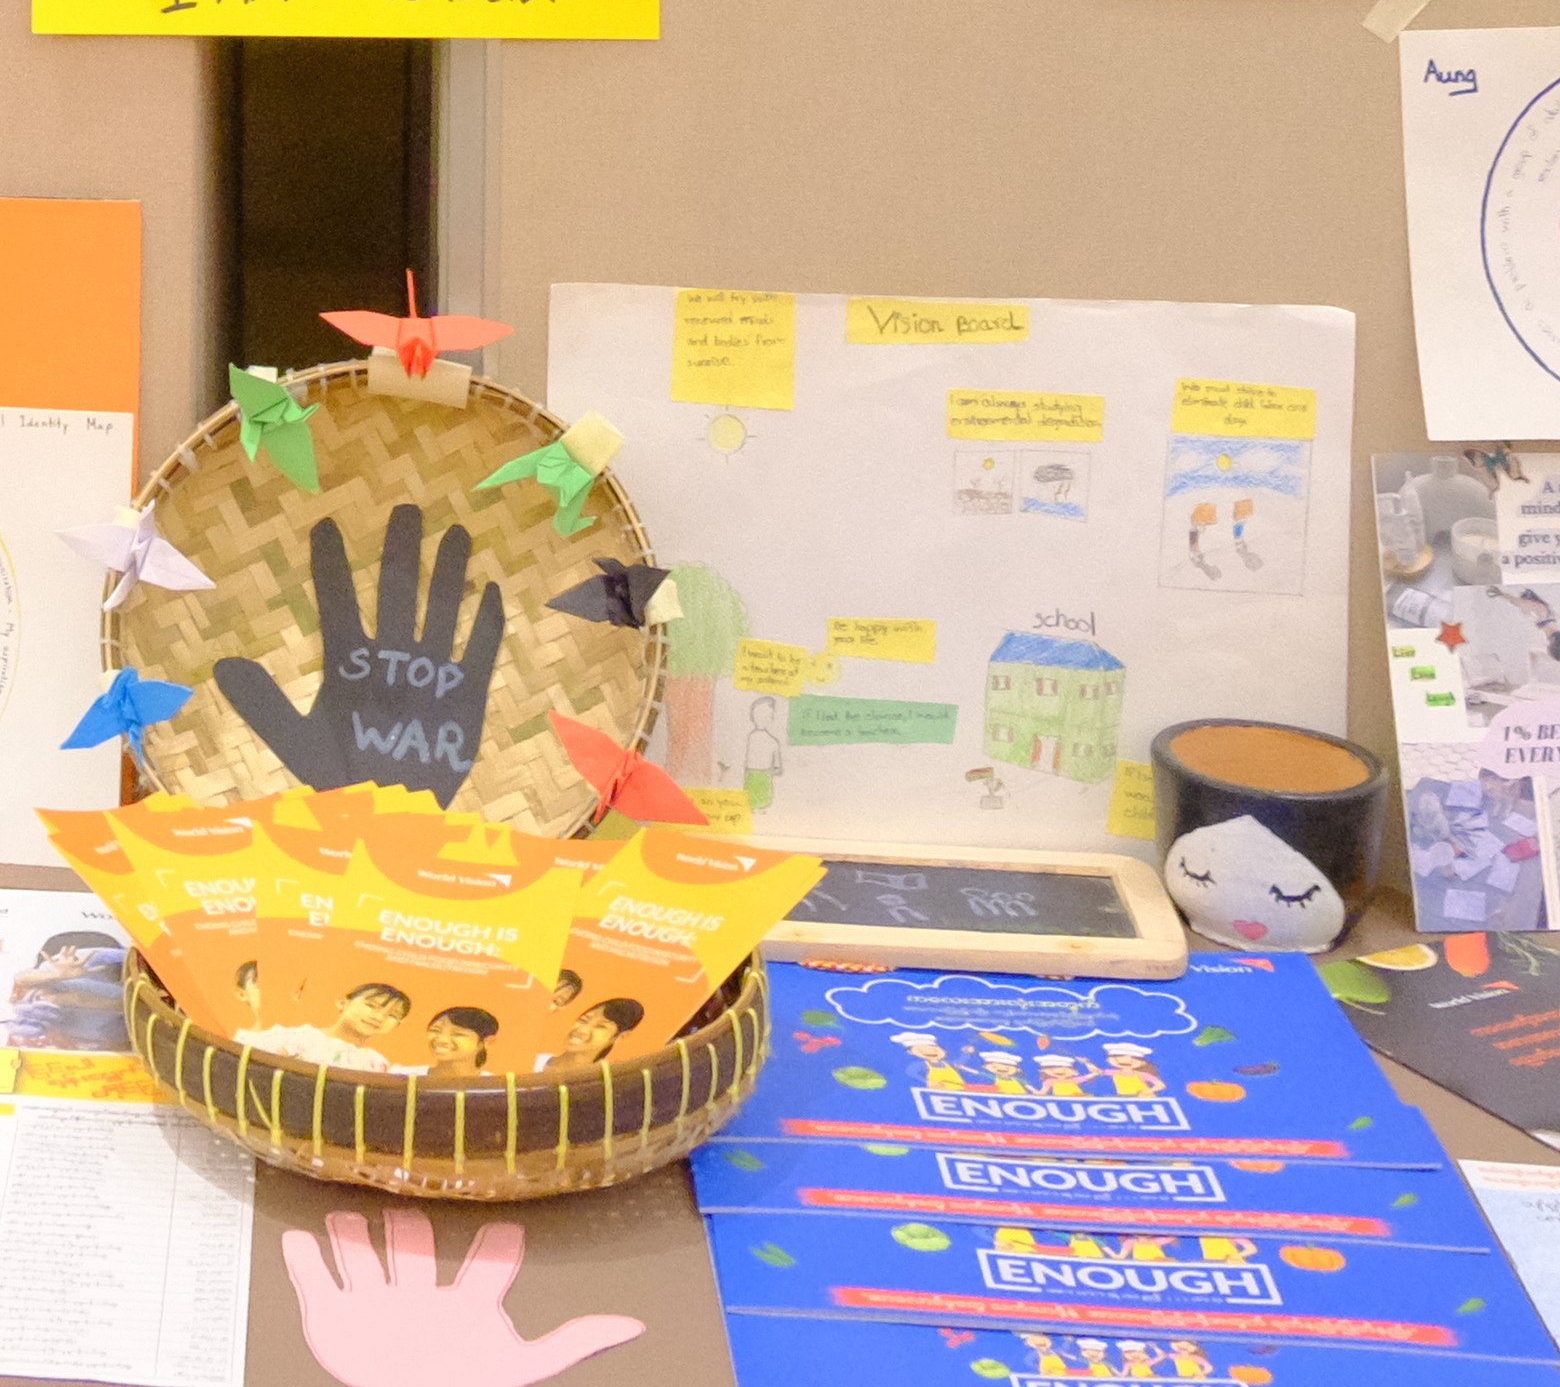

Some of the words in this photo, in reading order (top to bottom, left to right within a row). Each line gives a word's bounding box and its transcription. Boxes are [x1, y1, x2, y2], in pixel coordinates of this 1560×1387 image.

[1423, 58, 1478, 91] Aung
[866, 304, 945, 336] Vision
[18, 414, 69, 435] Identity
[86, 417, 115, 434] Map
[1542, 480, 1556, 494] A
[1517, 532, 1551, 547] give
[1501, 554, 1510, 566] a
[1031, 609, 1097, 635] school
[338, 648, 465, 699] STOP
[351, 710, 474, 773] WAR
[1503, 725, 1533, 743] 1%
[416, 869, 458, 883] World
[378, 908, 491, 942] ENOUGH
[495, 926, 520, 942] IS
[608, 895, 701, 929] ENOUGH
[700, 913, 726, 932] IS
[379, 928, 502, 958] ENOUGH:
[1189, 963, 1254, 975] Vision
[929, 1095, 1168, 1126] ENOUGH
[950, 1164, 1201, 1196] ENOUGH
[993, 1258, 1263, 1297] ENOUGH
